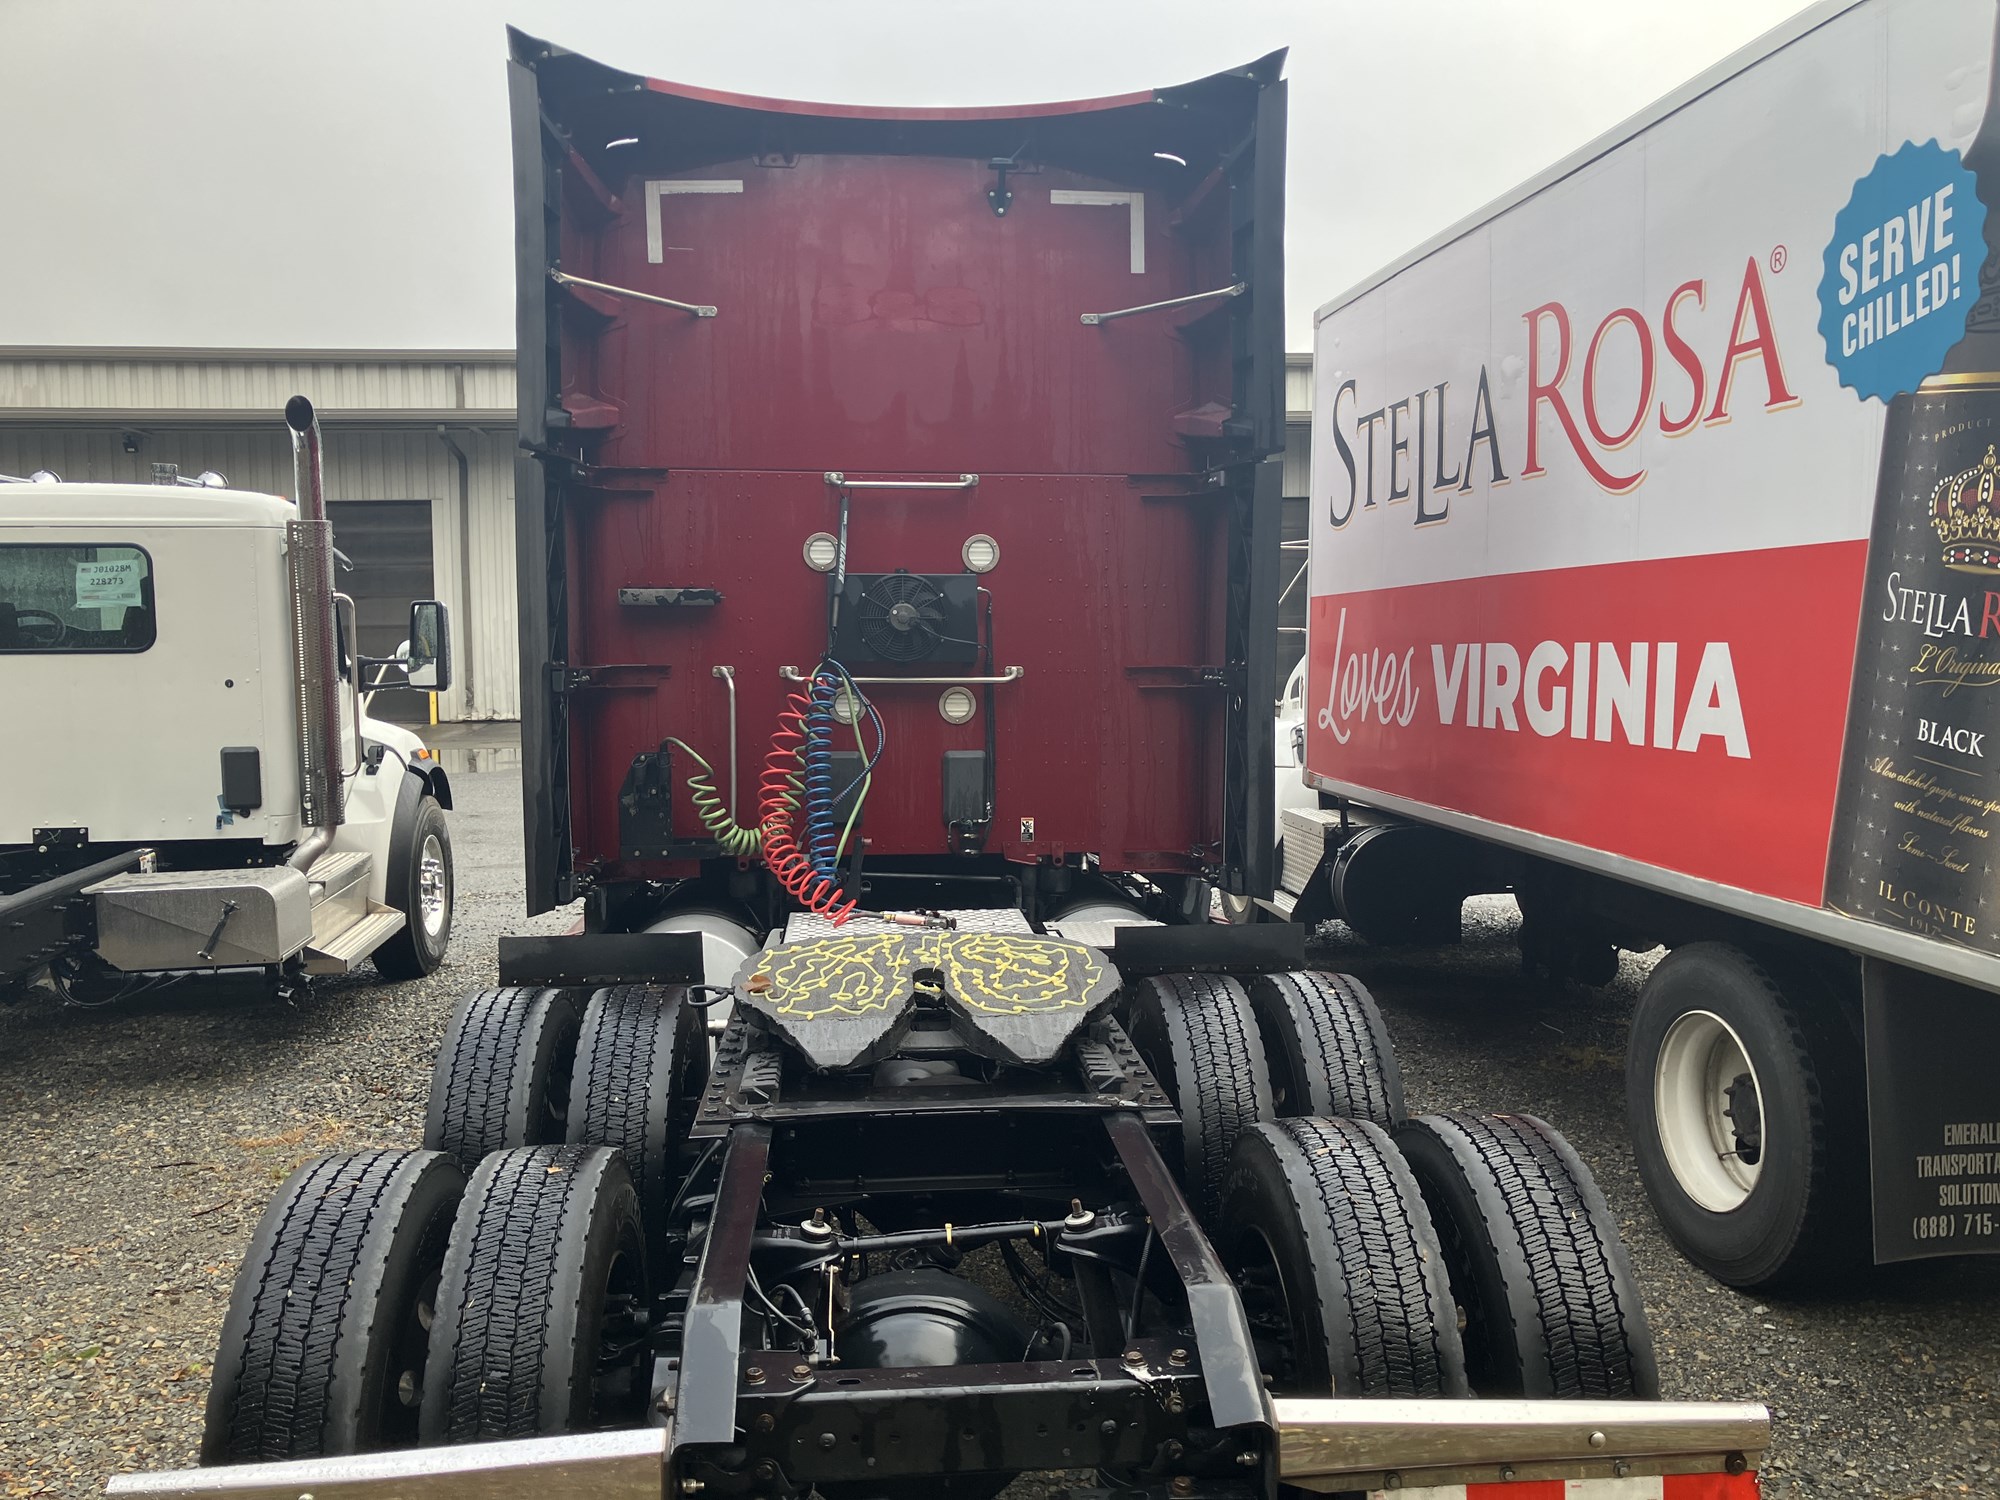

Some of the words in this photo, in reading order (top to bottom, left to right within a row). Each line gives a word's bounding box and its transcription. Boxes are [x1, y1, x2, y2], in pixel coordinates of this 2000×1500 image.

[1838, 183, 1954, 304] SERVE
[1842, 253, 1960, 357] CHILLED!
[1330, 364, 1510, 530] STELLA
[1521, 256, 1801, 493] ROSA
[1934, 417, 1992, 443] PRODUCT
[90, 578, 124, 586] 228273
[1883, 572, 1974, 638] STELLA
[1318, 607, 1419, 744] Loves
[1431, 641, 1751, 759] VIRGINIA
[1917, 718, 1985, 758] BLACK
[1870, 757, 1890, 774] A
[1882, 761, 1896, 779] low
[1896, 768, 1937, 790] alcohol
[1924, 784, 1957, 803] grape
[1958, 794, 1983, 808] wine
[1894, 799, 1920, 814] with
[1917, 810, 1957, 827] natural
[1949, 813, 1989, 838] flavors
[1879, 880, 1896, 902] IL
[1903, 890, 1976, 935] CONTE
[1913, 1214, 1955, 1240] (888)
